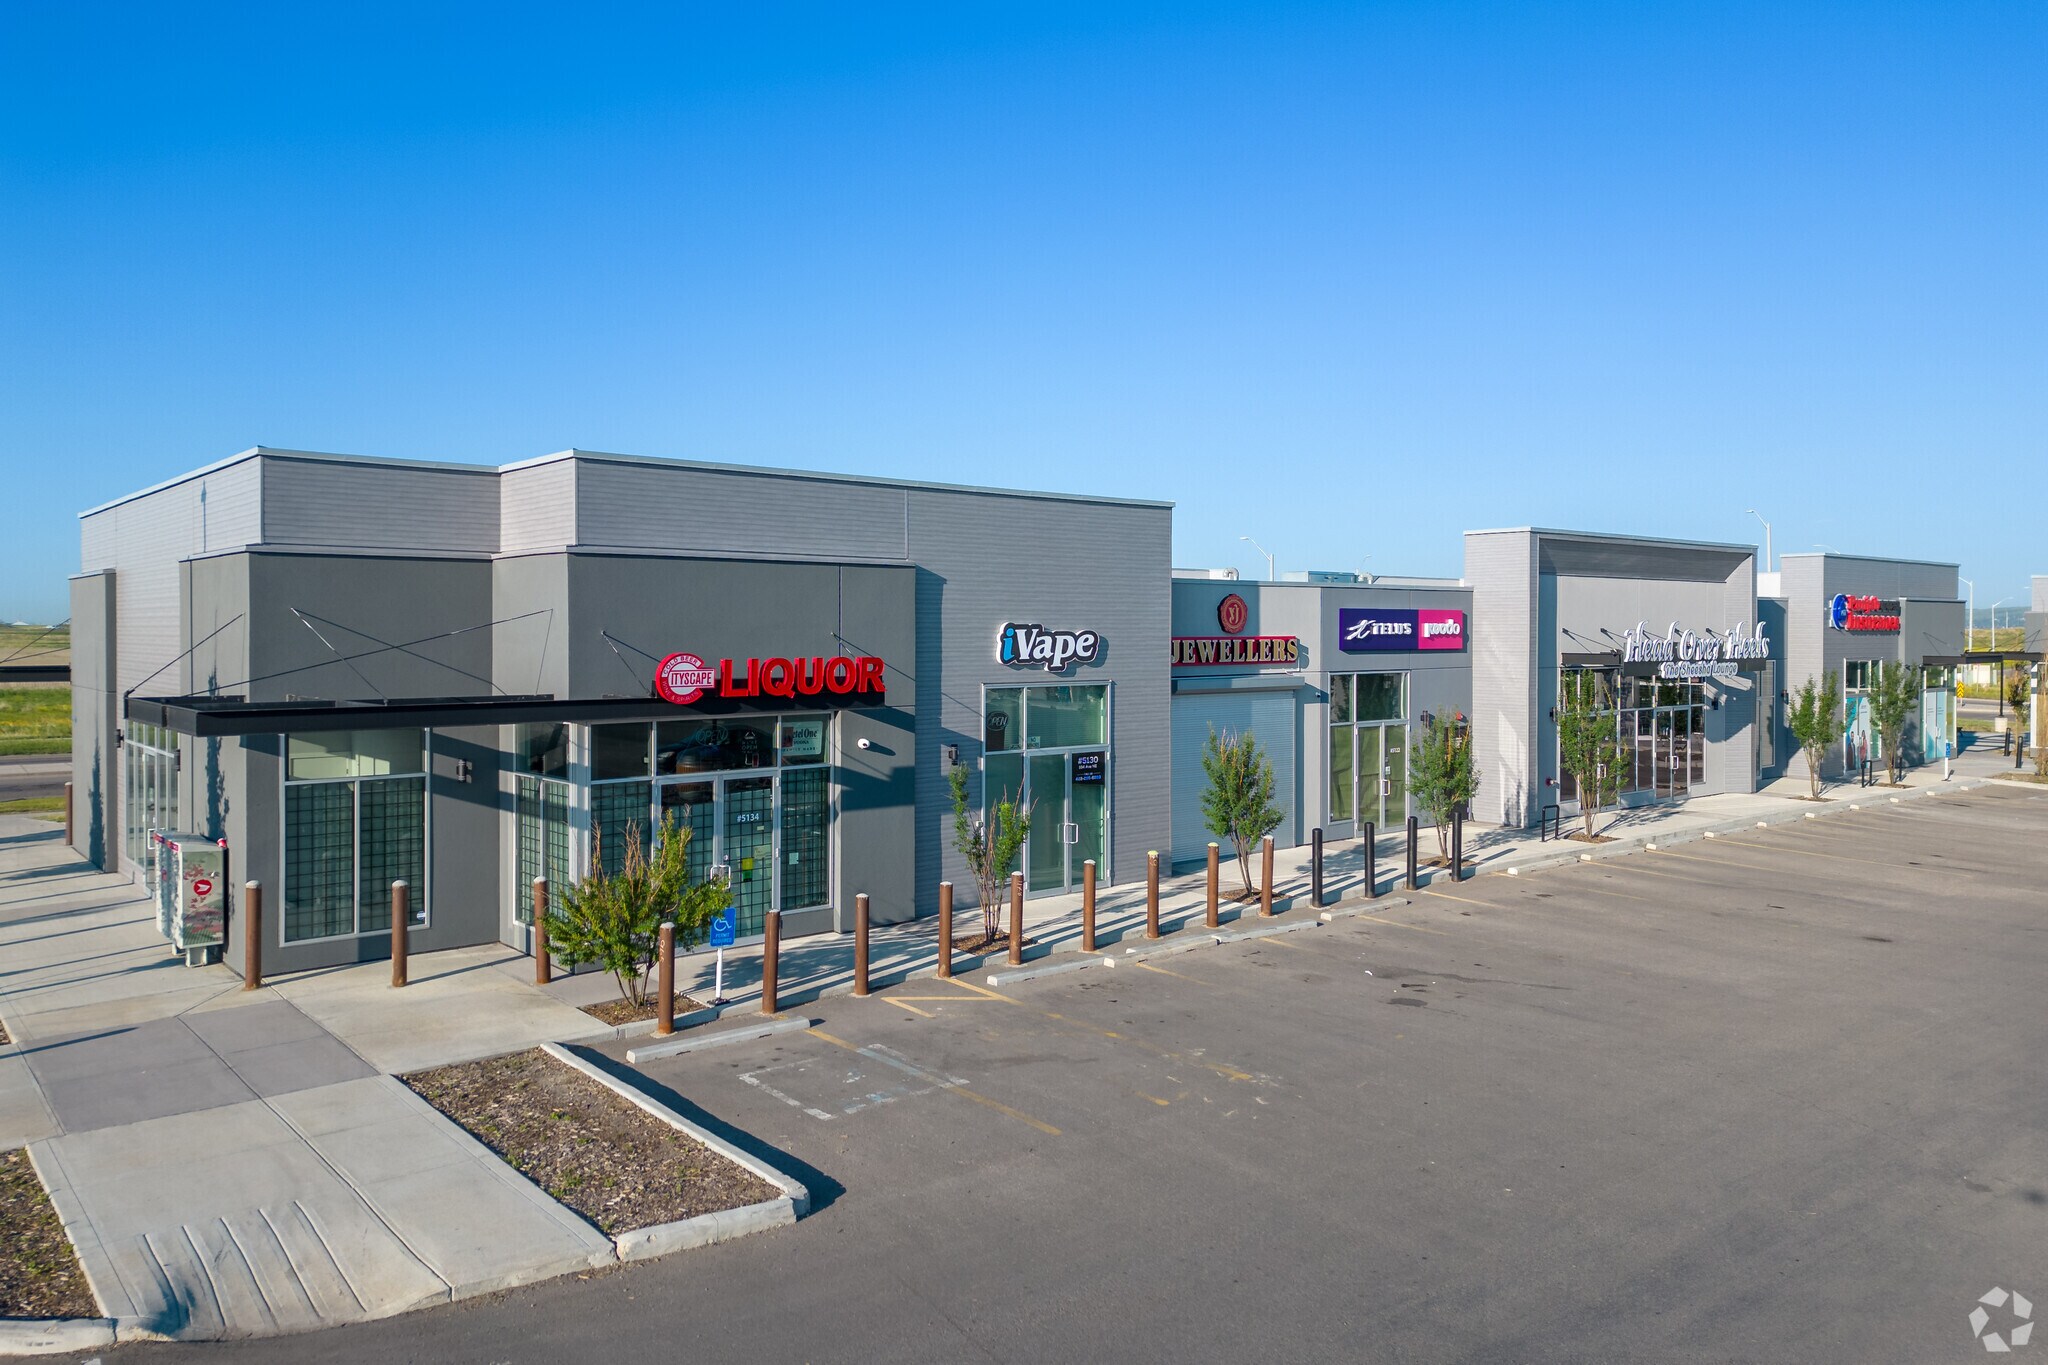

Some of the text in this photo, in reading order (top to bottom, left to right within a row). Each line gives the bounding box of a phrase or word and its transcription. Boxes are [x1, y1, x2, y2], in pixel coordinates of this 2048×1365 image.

[1371, 622, 1412, 635] TELUS
[1422, 618, 1461, 638] koodo
[1003, 627, 1095, 667] iVape
[1171, 638, 1299, 664] JEWELLERS
[1623, 620, 1771, 663] Head Over Heels
[720, 656, 887, 698] LIQUOR
[1077, 755, 1099, 764] #5130
[736, 812, 760, 822] #5134
